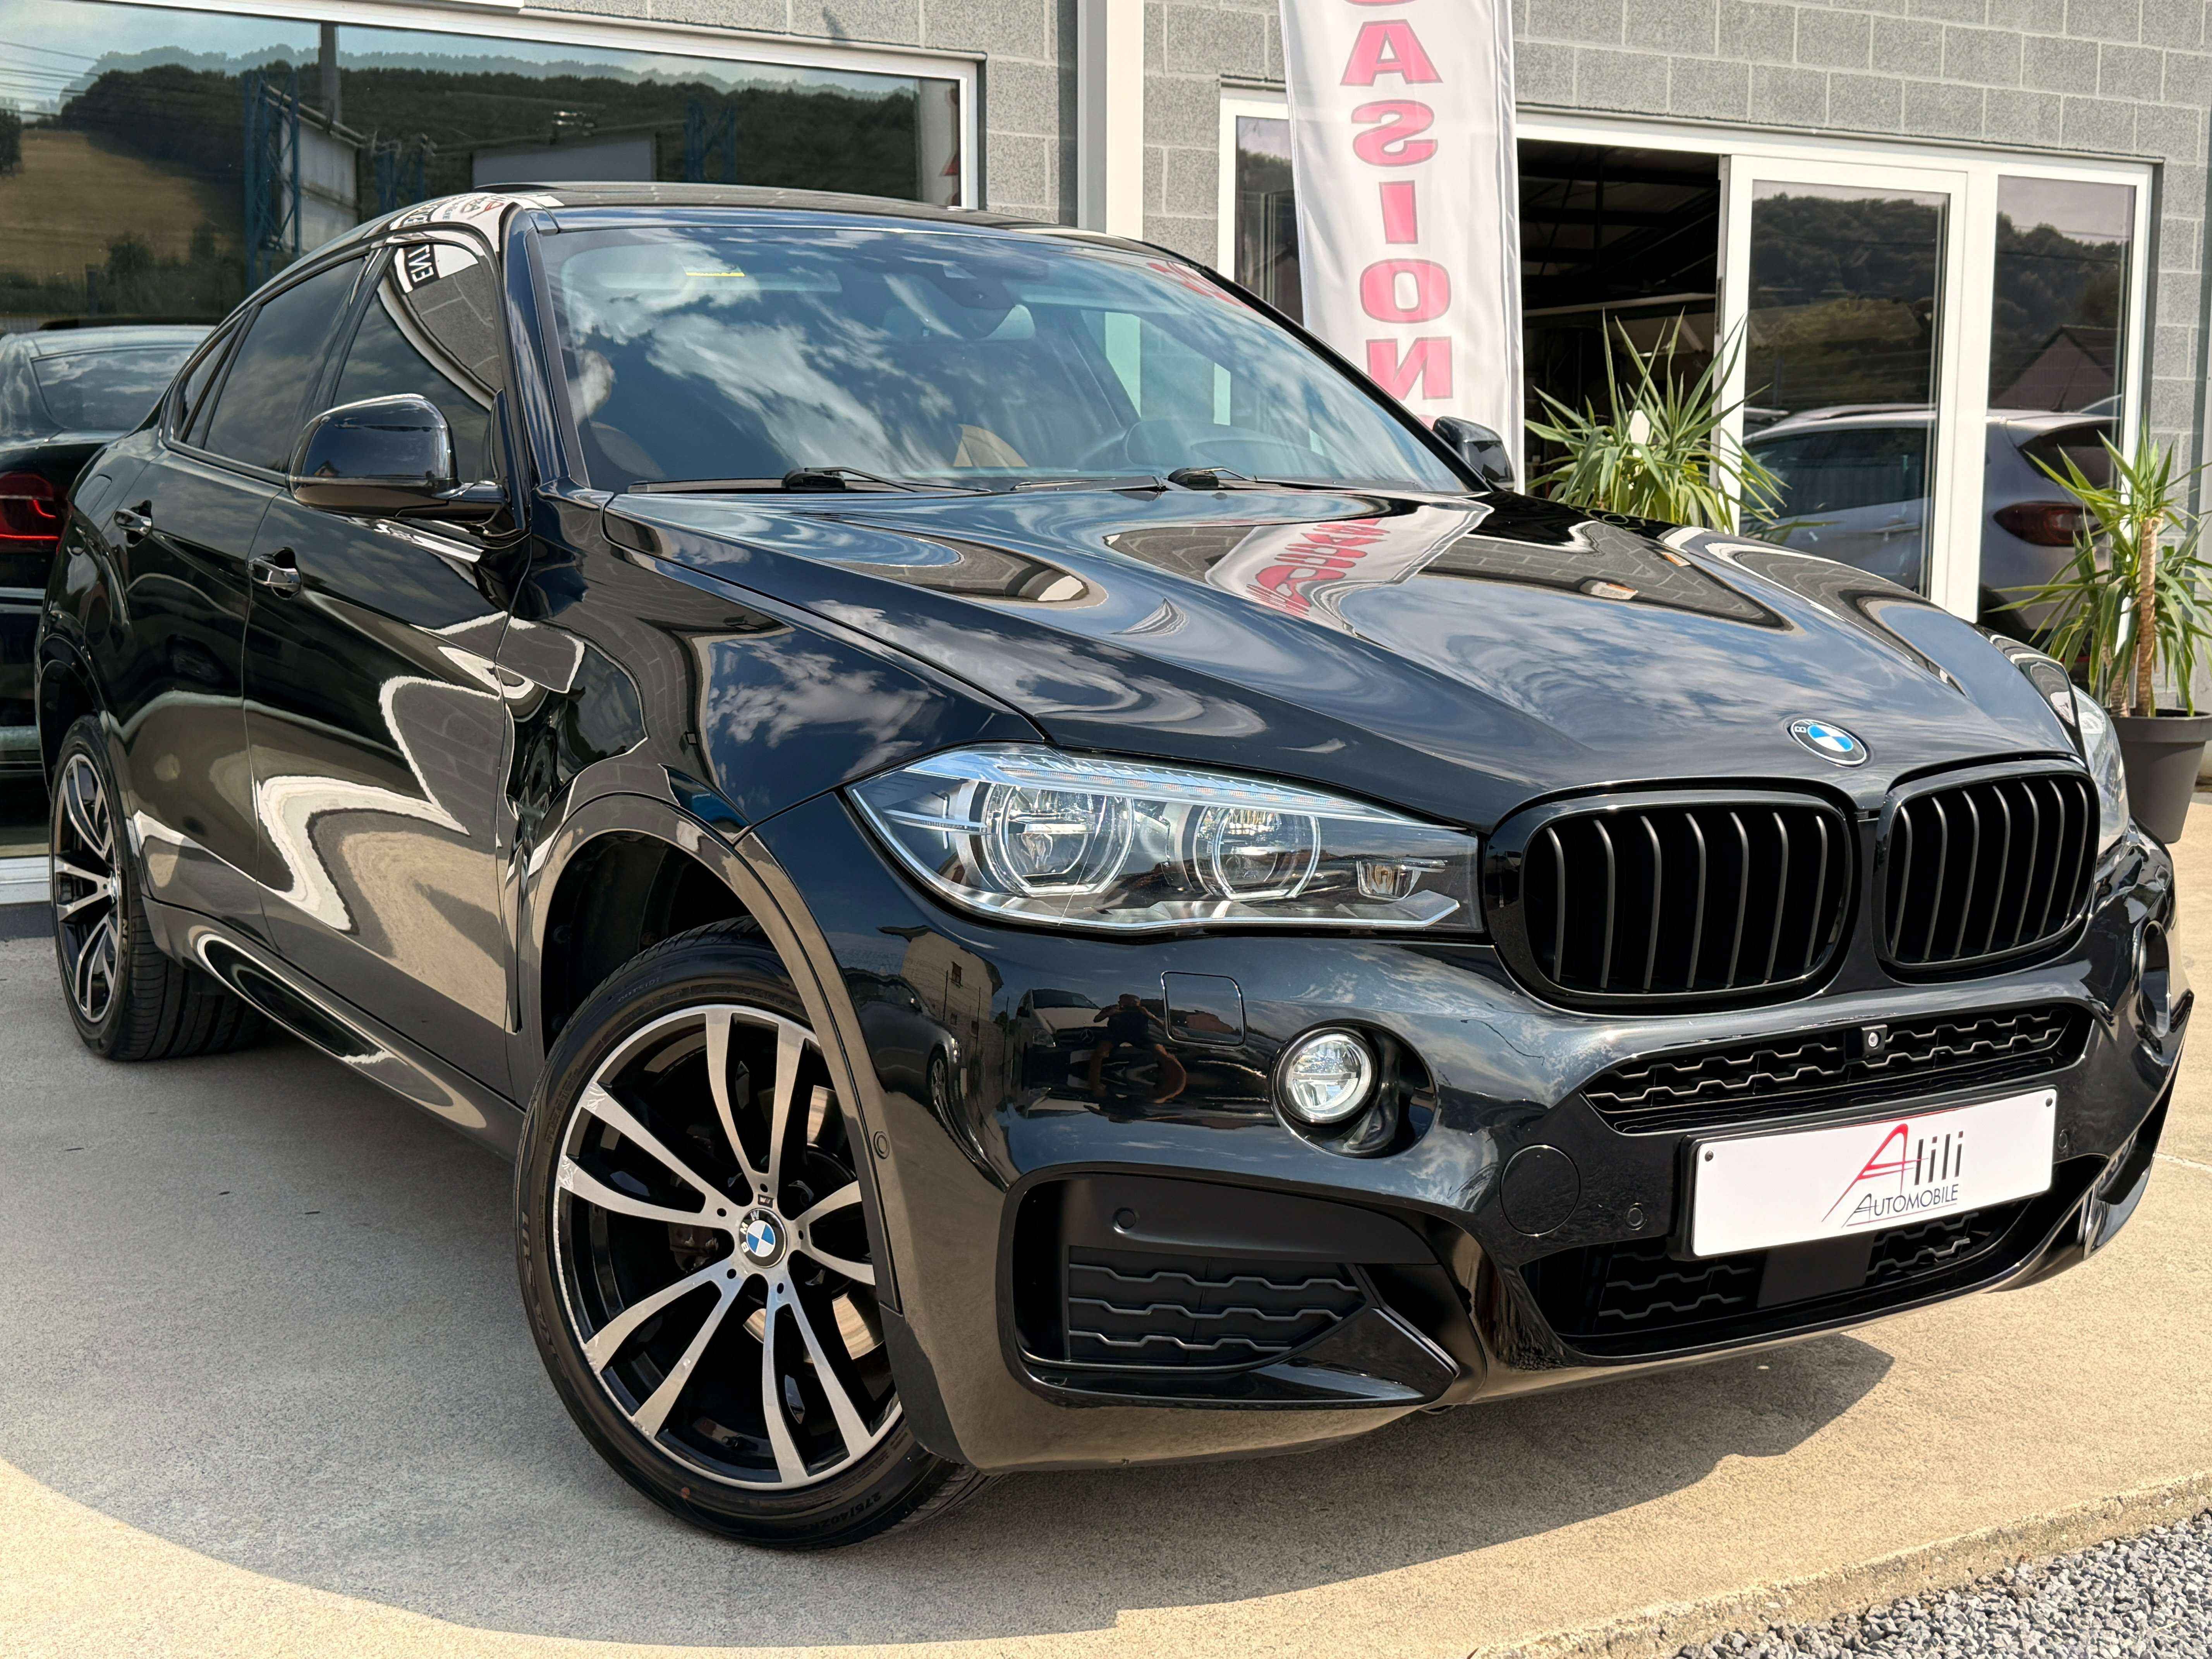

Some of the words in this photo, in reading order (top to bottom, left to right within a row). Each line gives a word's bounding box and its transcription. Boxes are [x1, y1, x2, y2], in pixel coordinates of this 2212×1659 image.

[1822, 1123, 1963, 1222] Alili
[1841, 1184, 1959, 1228] AUTOMOBILE
[740, 1210, 759, 1253] BMW
